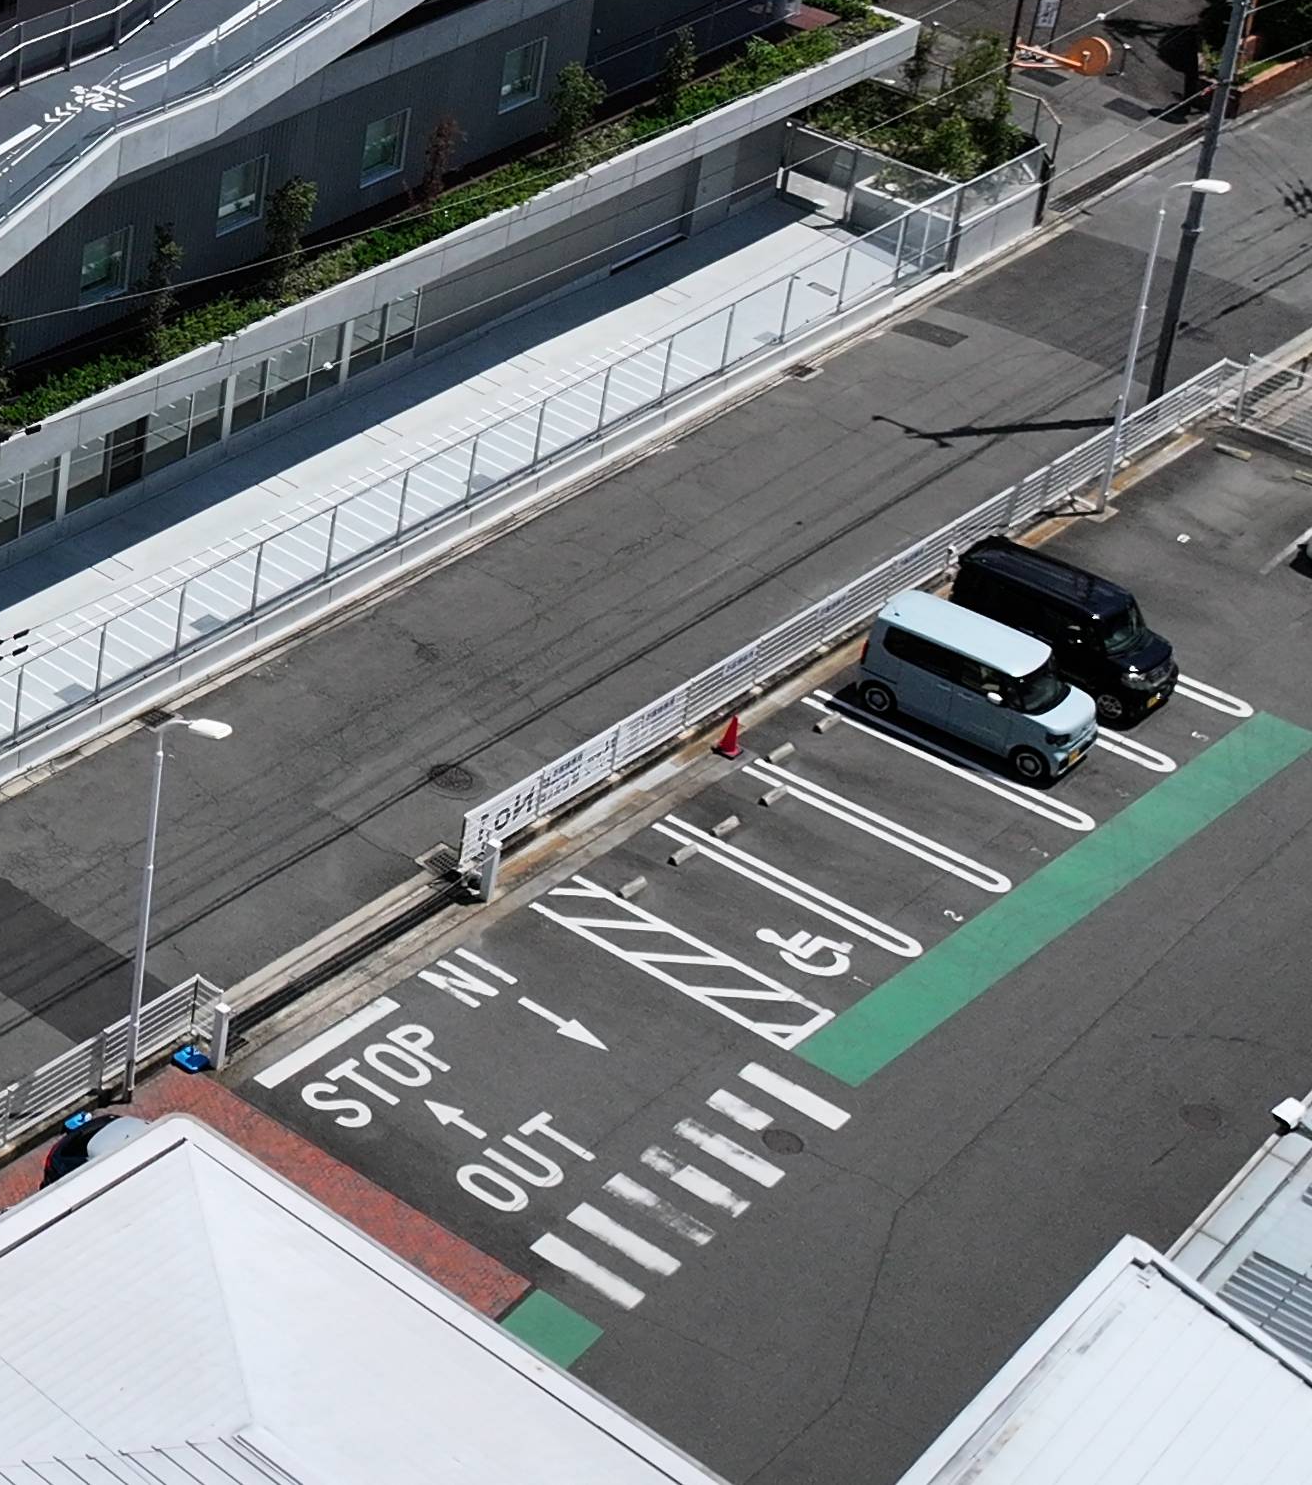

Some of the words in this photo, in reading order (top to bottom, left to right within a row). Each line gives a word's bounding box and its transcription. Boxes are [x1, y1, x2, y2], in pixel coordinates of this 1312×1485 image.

[419, 948, 518, 1007] IN
[301, 1023, 450, 1128] STOP
[456, 1112, 596, 1213] OUT
